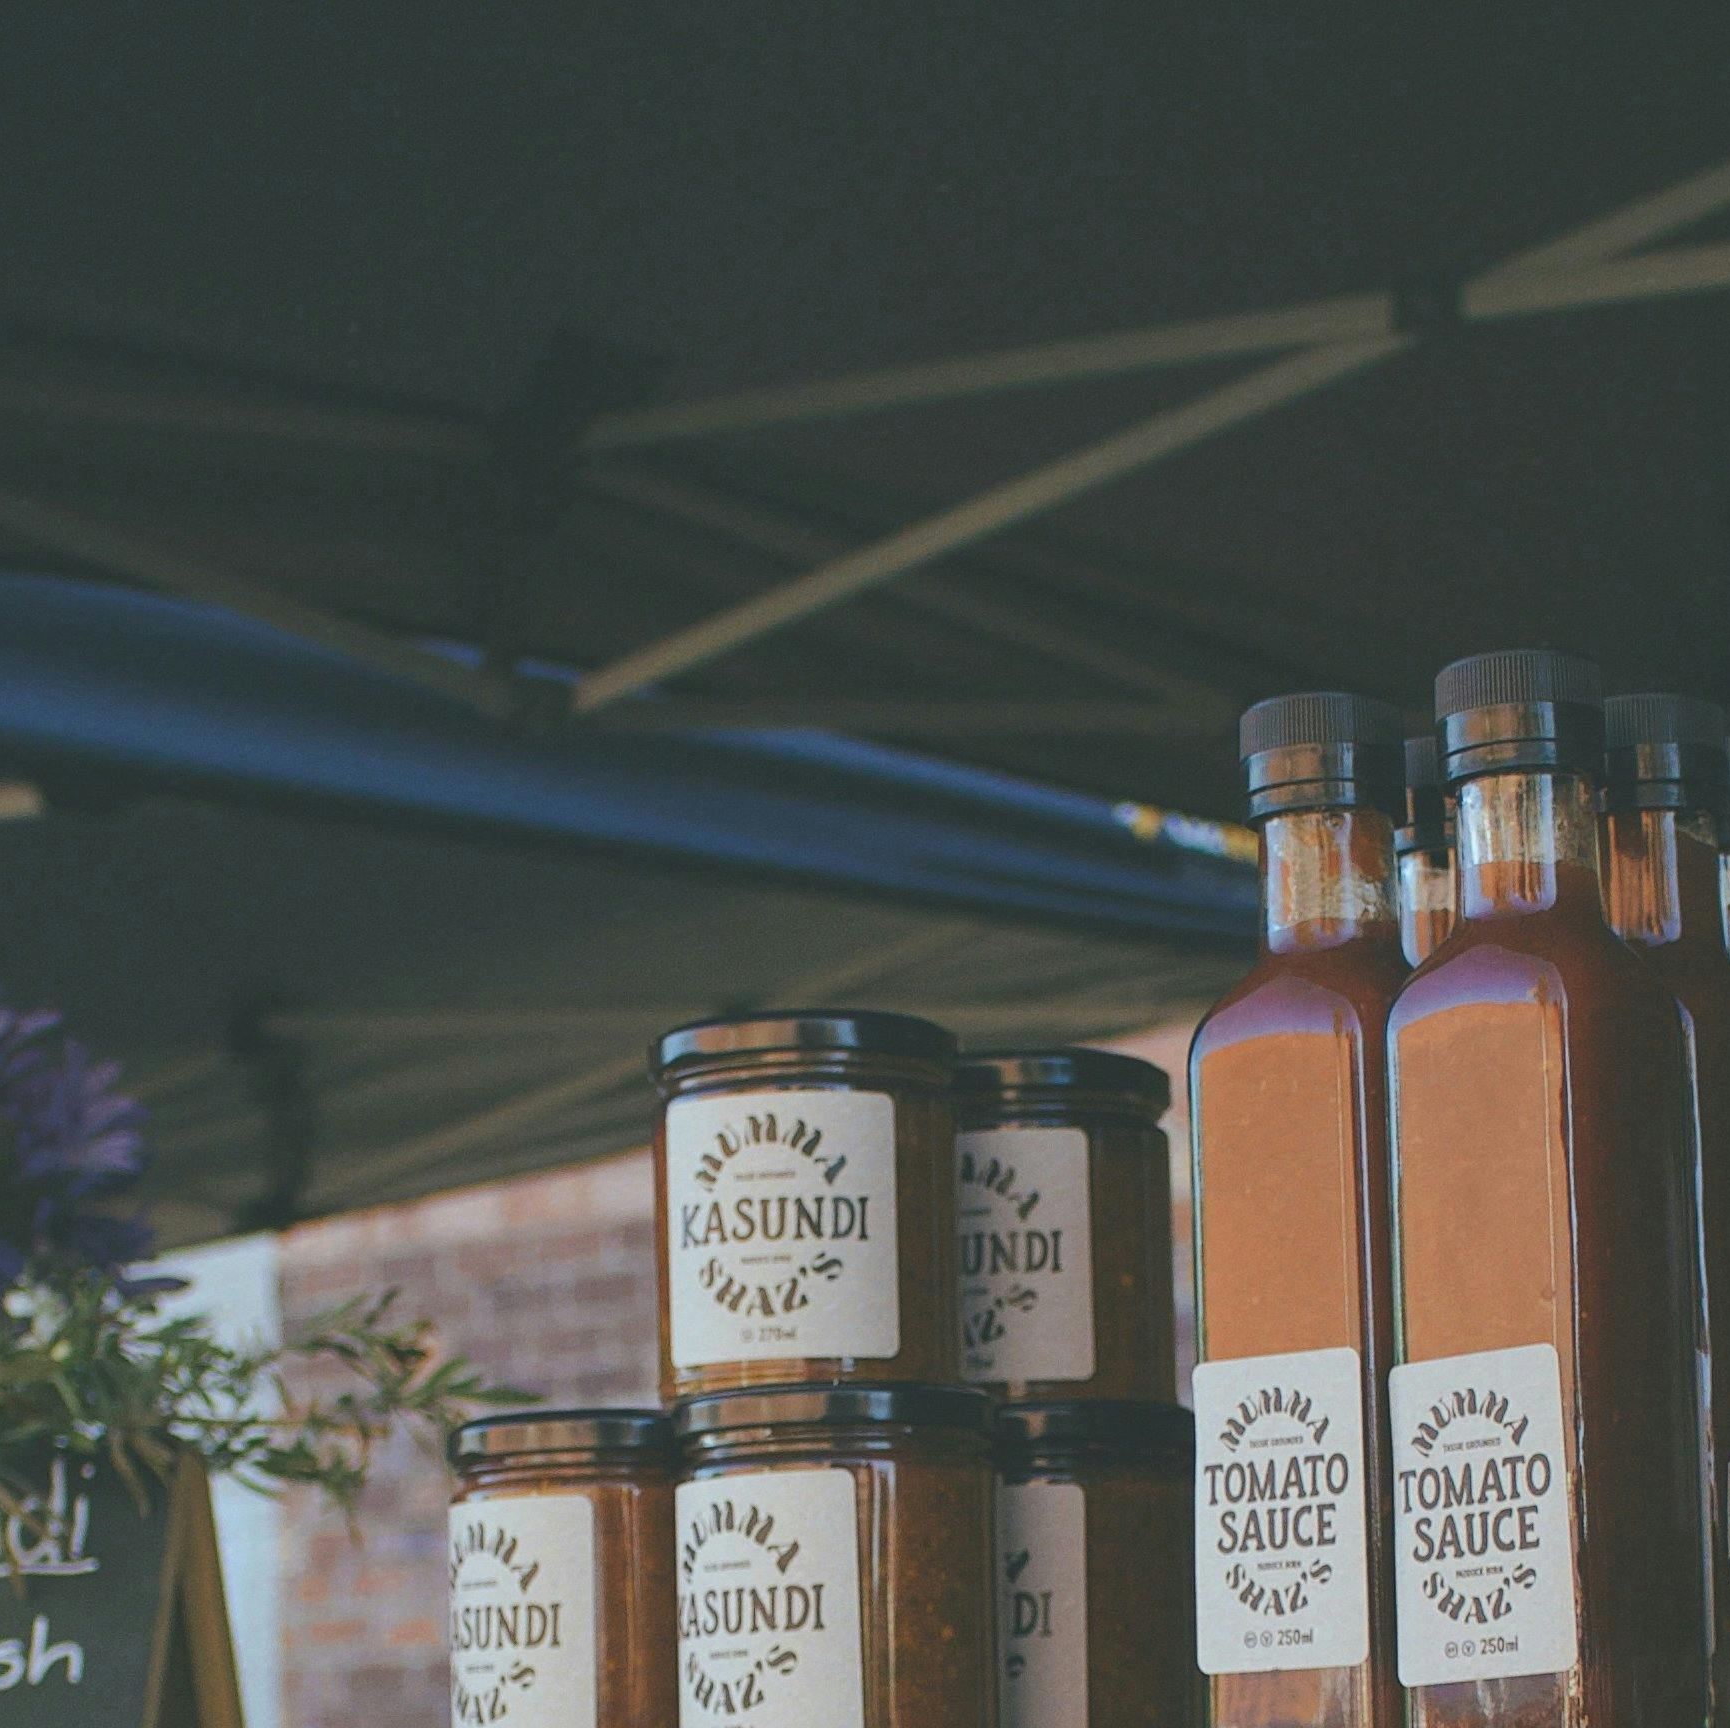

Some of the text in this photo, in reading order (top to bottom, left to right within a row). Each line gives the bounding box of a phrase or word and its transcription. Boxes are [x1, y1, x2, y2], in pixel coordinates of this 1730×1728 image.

[694, 1113, 848, 1193] MUMMA
[961, 1150, 1039, 1222] MMA
[681, 1196, 871, 1249] KASUNDI
[961, 1230, 1063, 1276] UNDI
[697, 1252, 845, 1318] SHAZ'S
[963, 1284, 1039, 1347] AZ'S
[1219, 1386, 1329, 1452] MUMMA
[1411, 1387, 1529, 1458] MUMMA
[1204, 1452, 1349, 1506] TOMATO
[1399, 1452, 1551, 1514] TOMATO
[1217, 1502, 1337, 1555] SAUCE
[1412, 1504, 1541, 1563] SAUCE
[1225, 1558, 1333, 1617] SHAZ'S
[1422, 1563, 1537, 1625] SHAZ'S
[451, 1602, 560, 1651] ASUNDI
[1277, 1628, 1314, 1646] 250ml
[1479, 1635, 1519, 1656] 250ml
